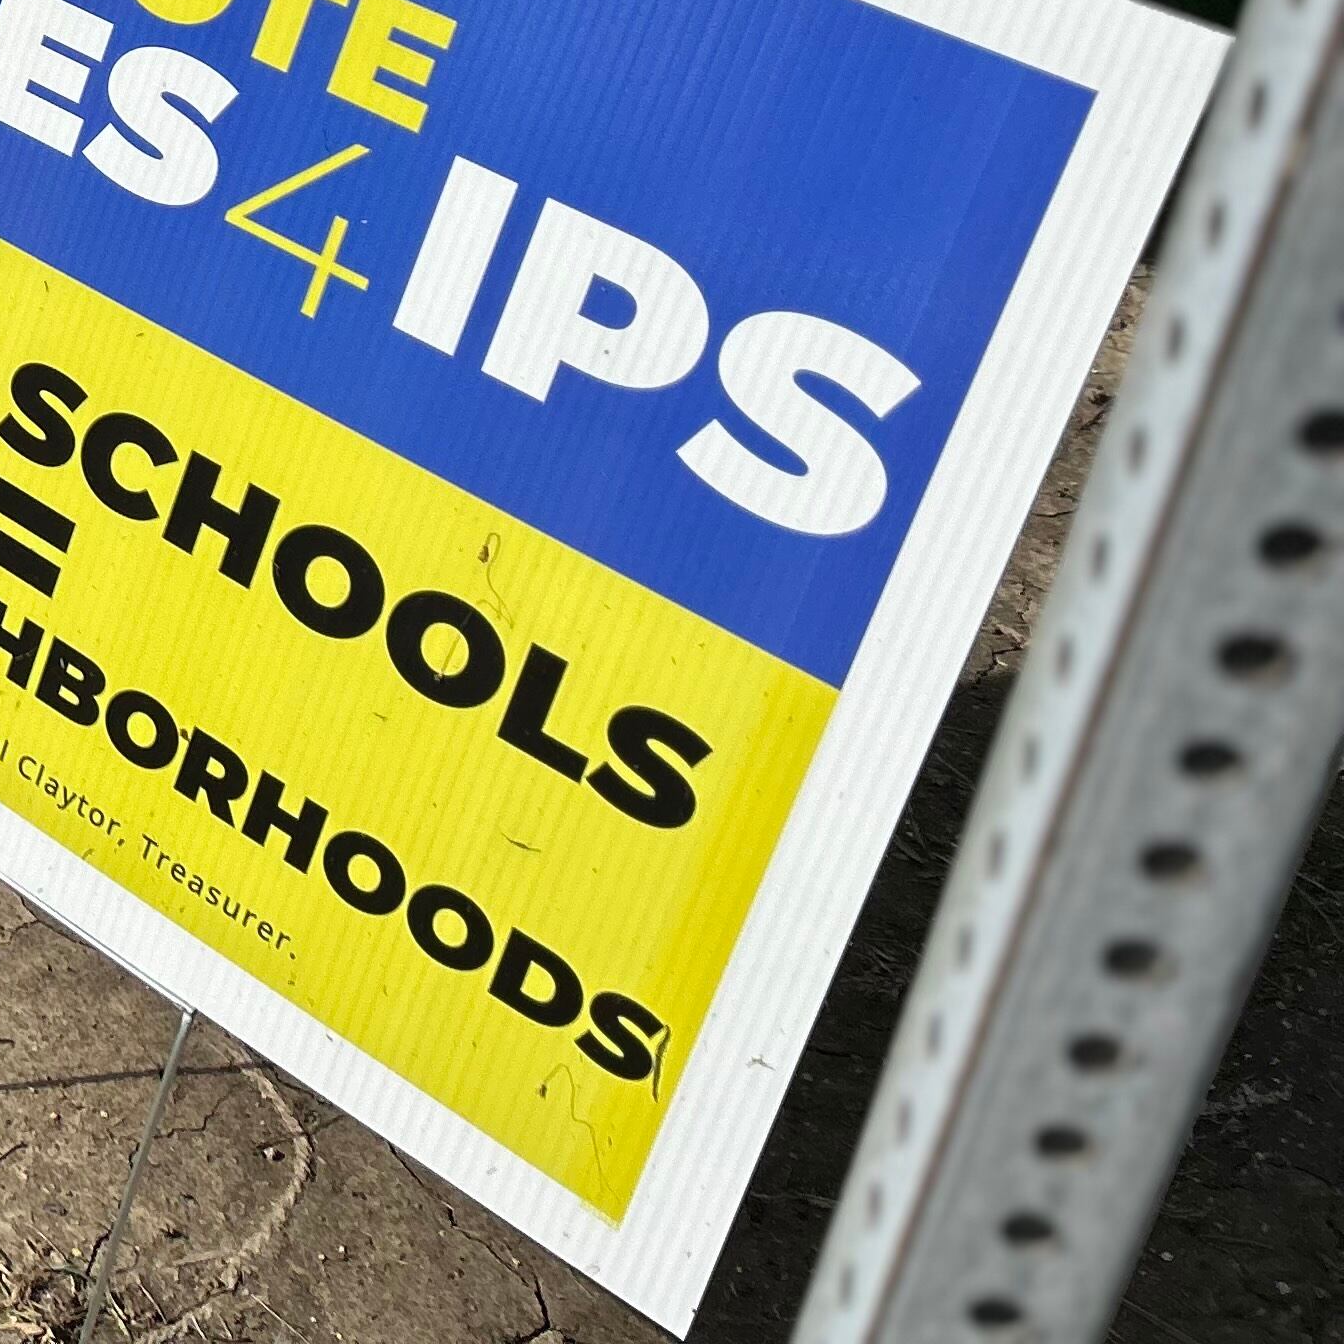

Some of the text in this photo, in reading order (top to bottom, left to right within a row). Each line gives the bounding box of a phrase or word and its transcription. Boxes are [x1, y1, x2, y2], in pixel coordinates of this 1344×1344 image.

[224, 143, 371, 319] 4
[392, 155, 921, 536] IPS
[142, 833, 296, 960] Treasurer.
